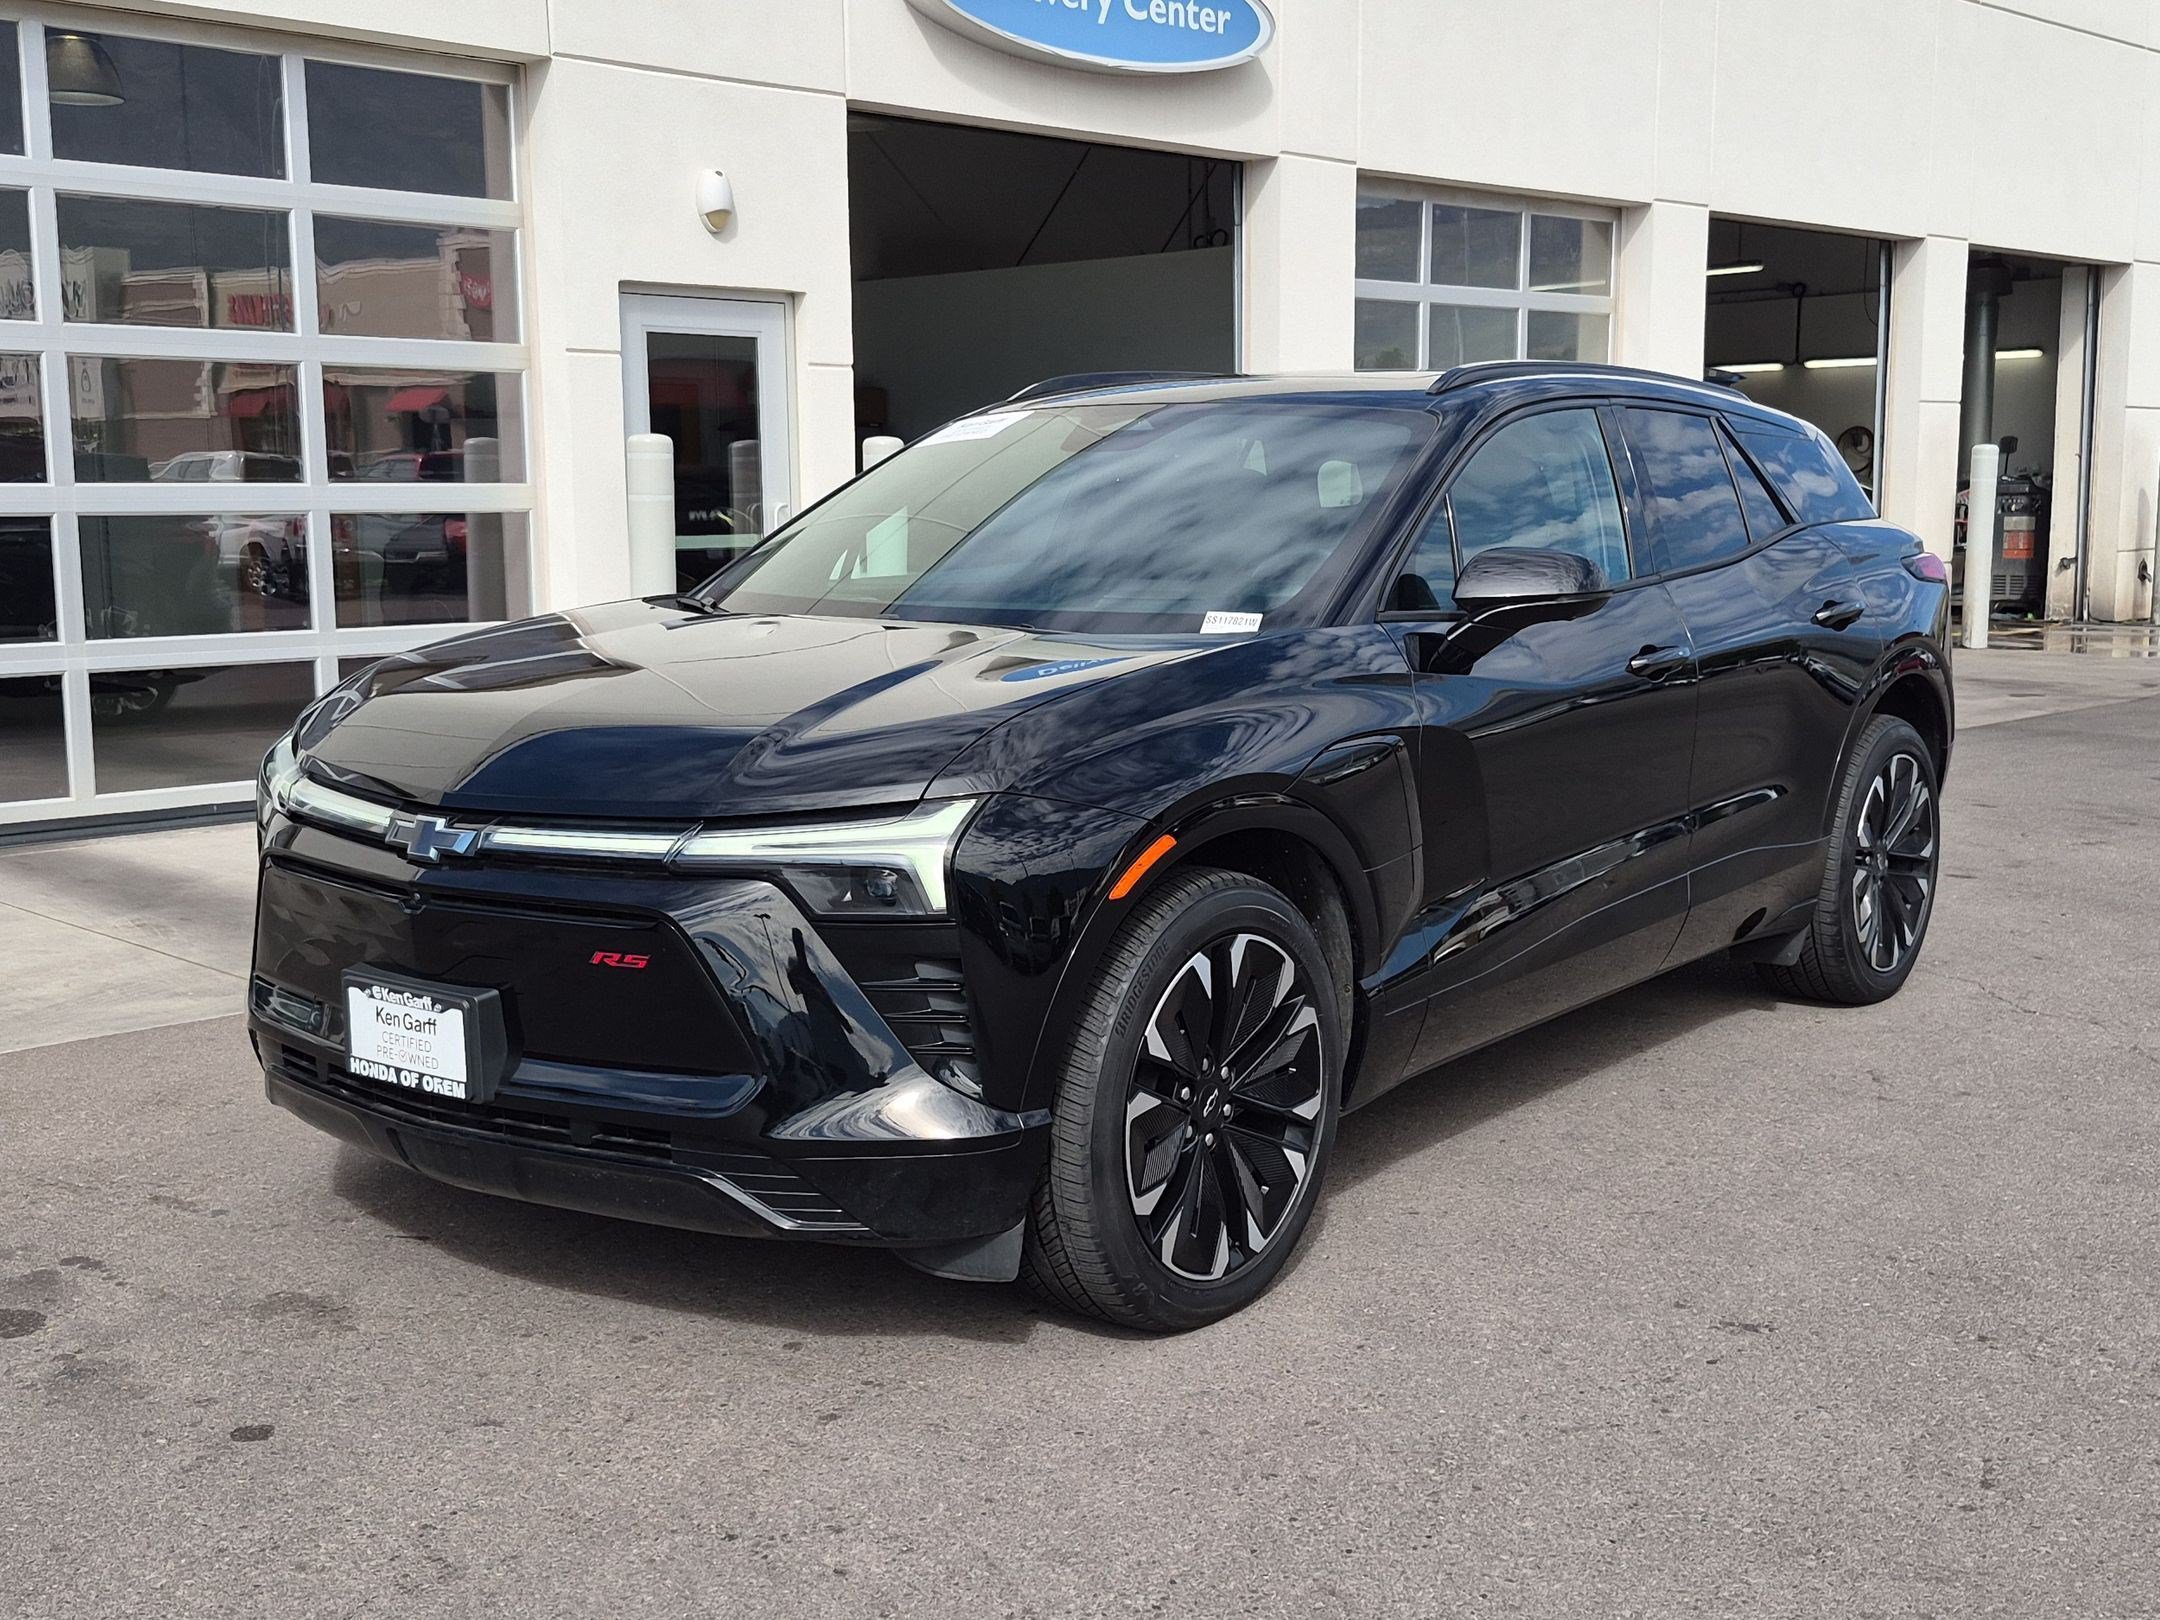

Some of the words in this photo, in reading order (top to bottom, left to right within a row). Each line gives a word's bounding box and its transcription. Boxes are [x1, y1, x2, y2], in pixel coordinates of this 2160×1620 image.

[1123, 0, 1232, 34] Center
[589, 951, 651, 968] RS
[381, 987, 404, 1006] Ken
[403, 992, 432, 1011] Garff
[1115, 938, 1170, 1038] BRIDGESTONE
[376, 1005, 401, 1028] Ken
[402, 1012, 437, 1036] Garff
[382, 1031, 432, 1053] CERTIFIED
[350, 1057, 398, 1084] HONDA
[400, 1069, 420, 1089] OF
[422, 1075, 466, 1100] OREM
